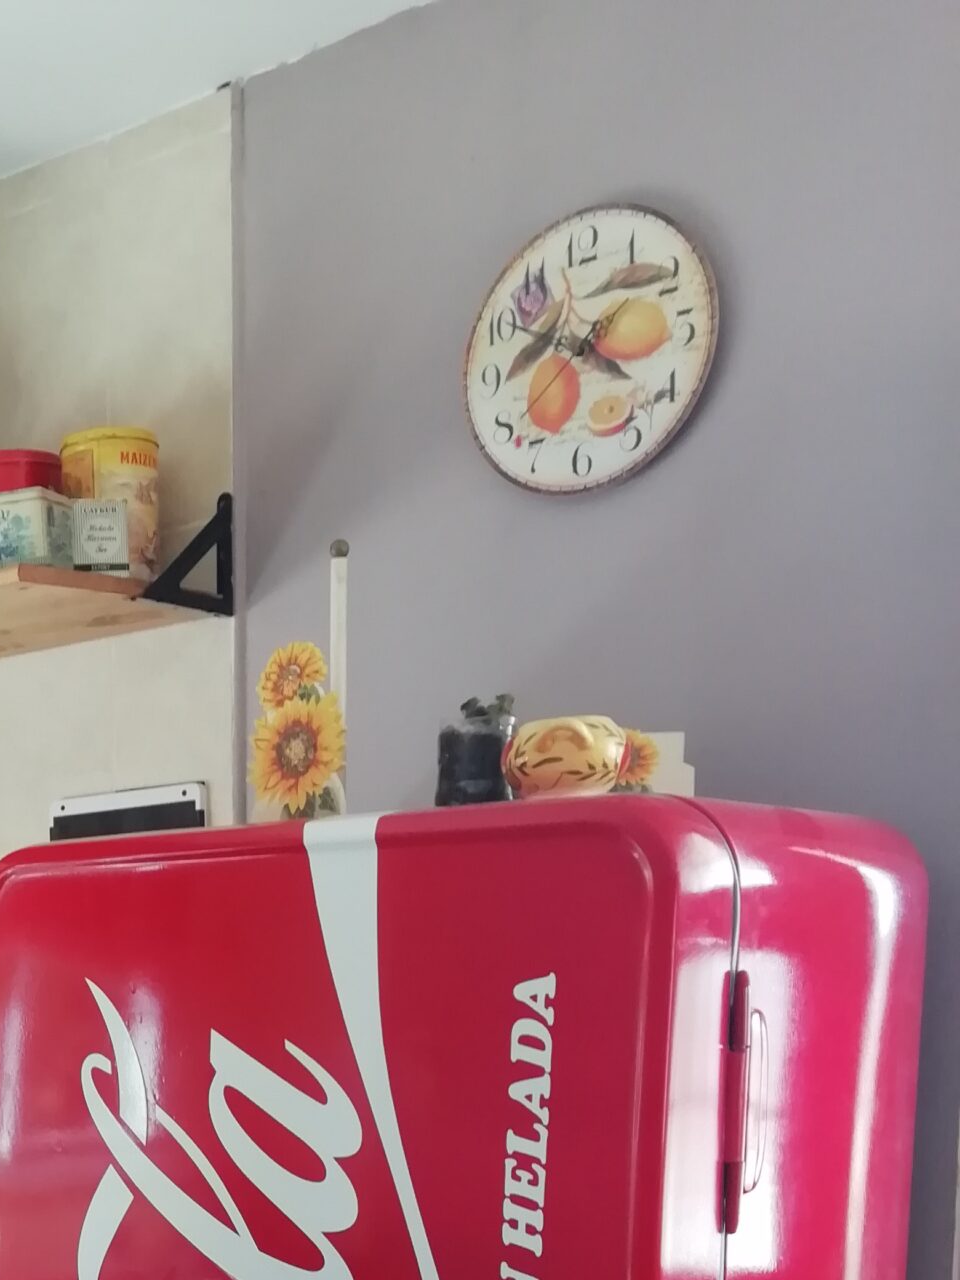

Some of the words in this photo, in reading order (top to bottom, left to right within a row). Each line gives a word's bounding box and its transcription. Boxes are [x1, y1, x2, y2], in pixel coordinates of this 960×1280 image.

[567, 224, 599, 269] 12
[628, 228, 636, 266] 1
[658, 255, 680, 297] 2
[489, 306, 517, 347] 10
[481, 362, 501, 400] 9
[493, 410, 514, 446] 8
[619, 416, 642, 453] 5
[527, 437, 545, 474] 7
[571, 441, 593, 478] 6
[501, 971, 558, 1261] HELADA
